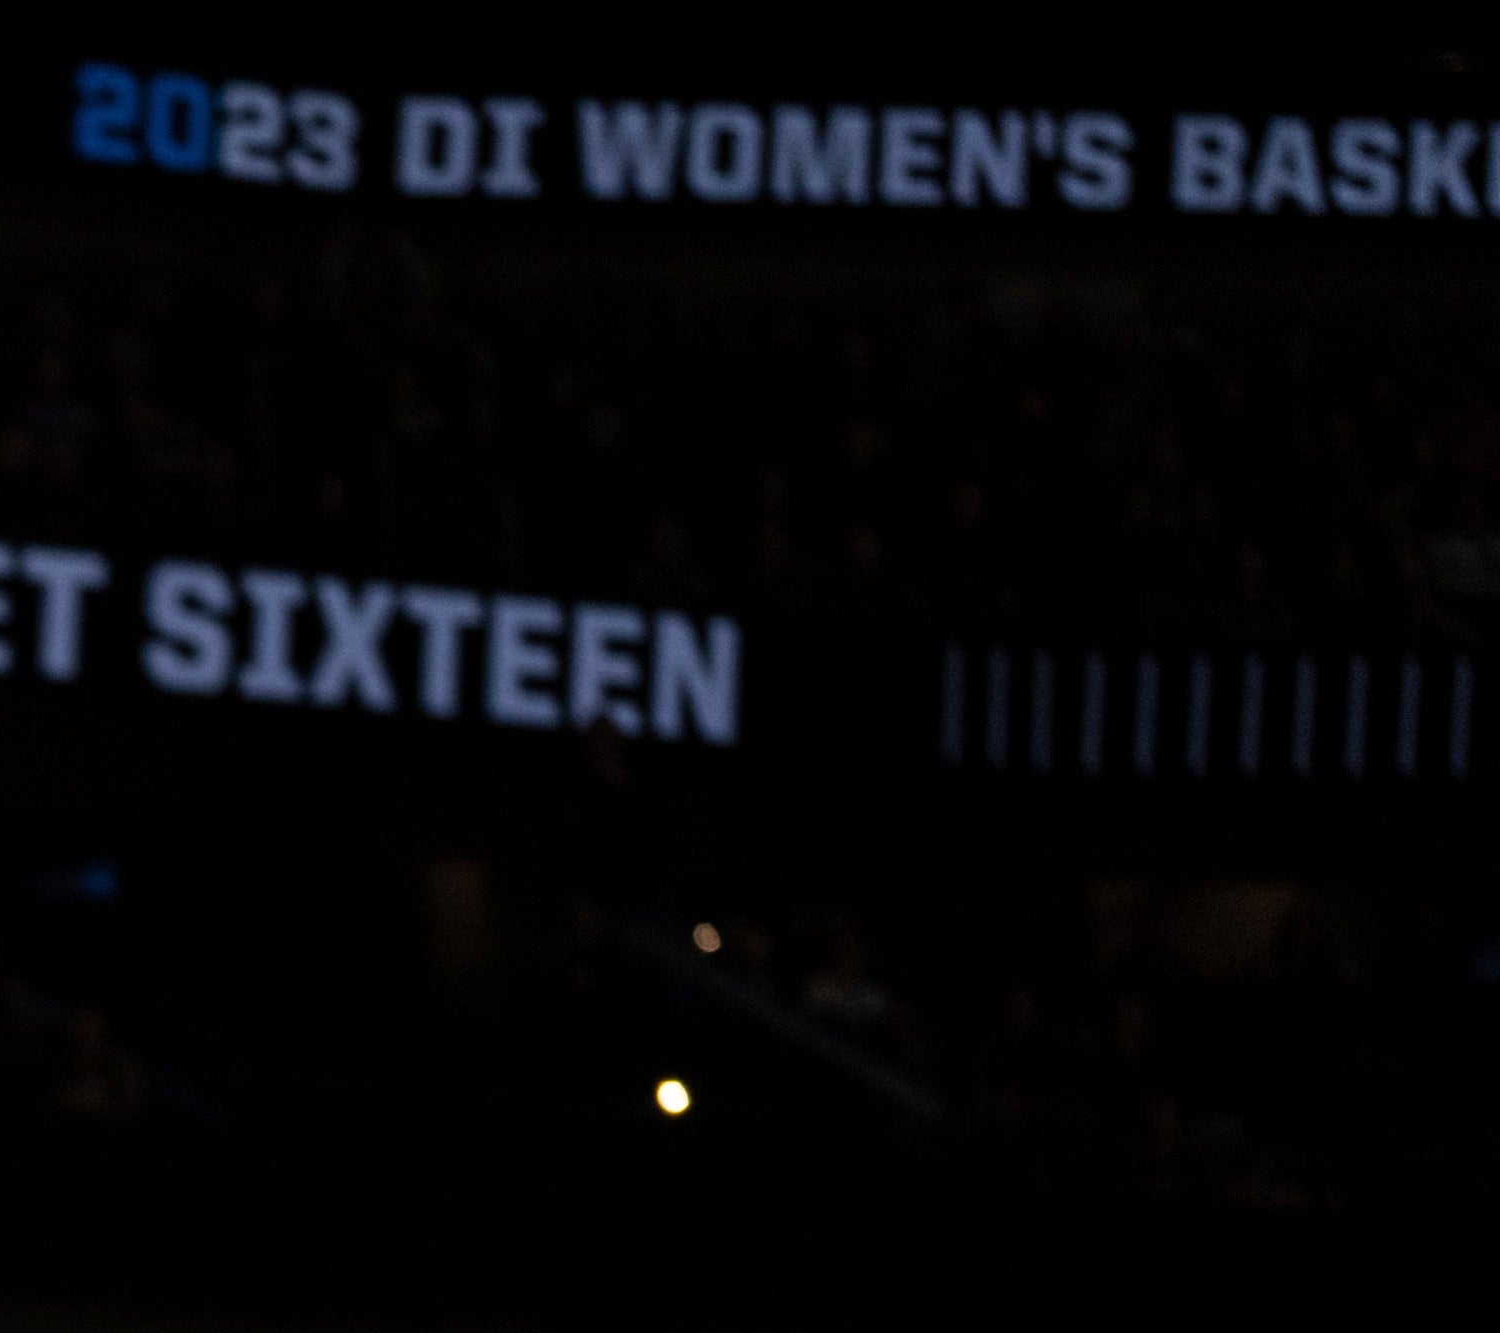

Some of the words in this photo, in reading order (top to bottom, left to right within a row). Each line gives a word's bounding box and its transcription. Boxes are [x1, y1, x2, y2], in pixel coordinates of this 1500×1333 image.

[73, 62, 358, 191] 2023
[578, 102, 1131, 208] WOMEN'S
[1171, 116, 1500, 217] BASK
[142, 562, 740, 742] SIXTEEN
